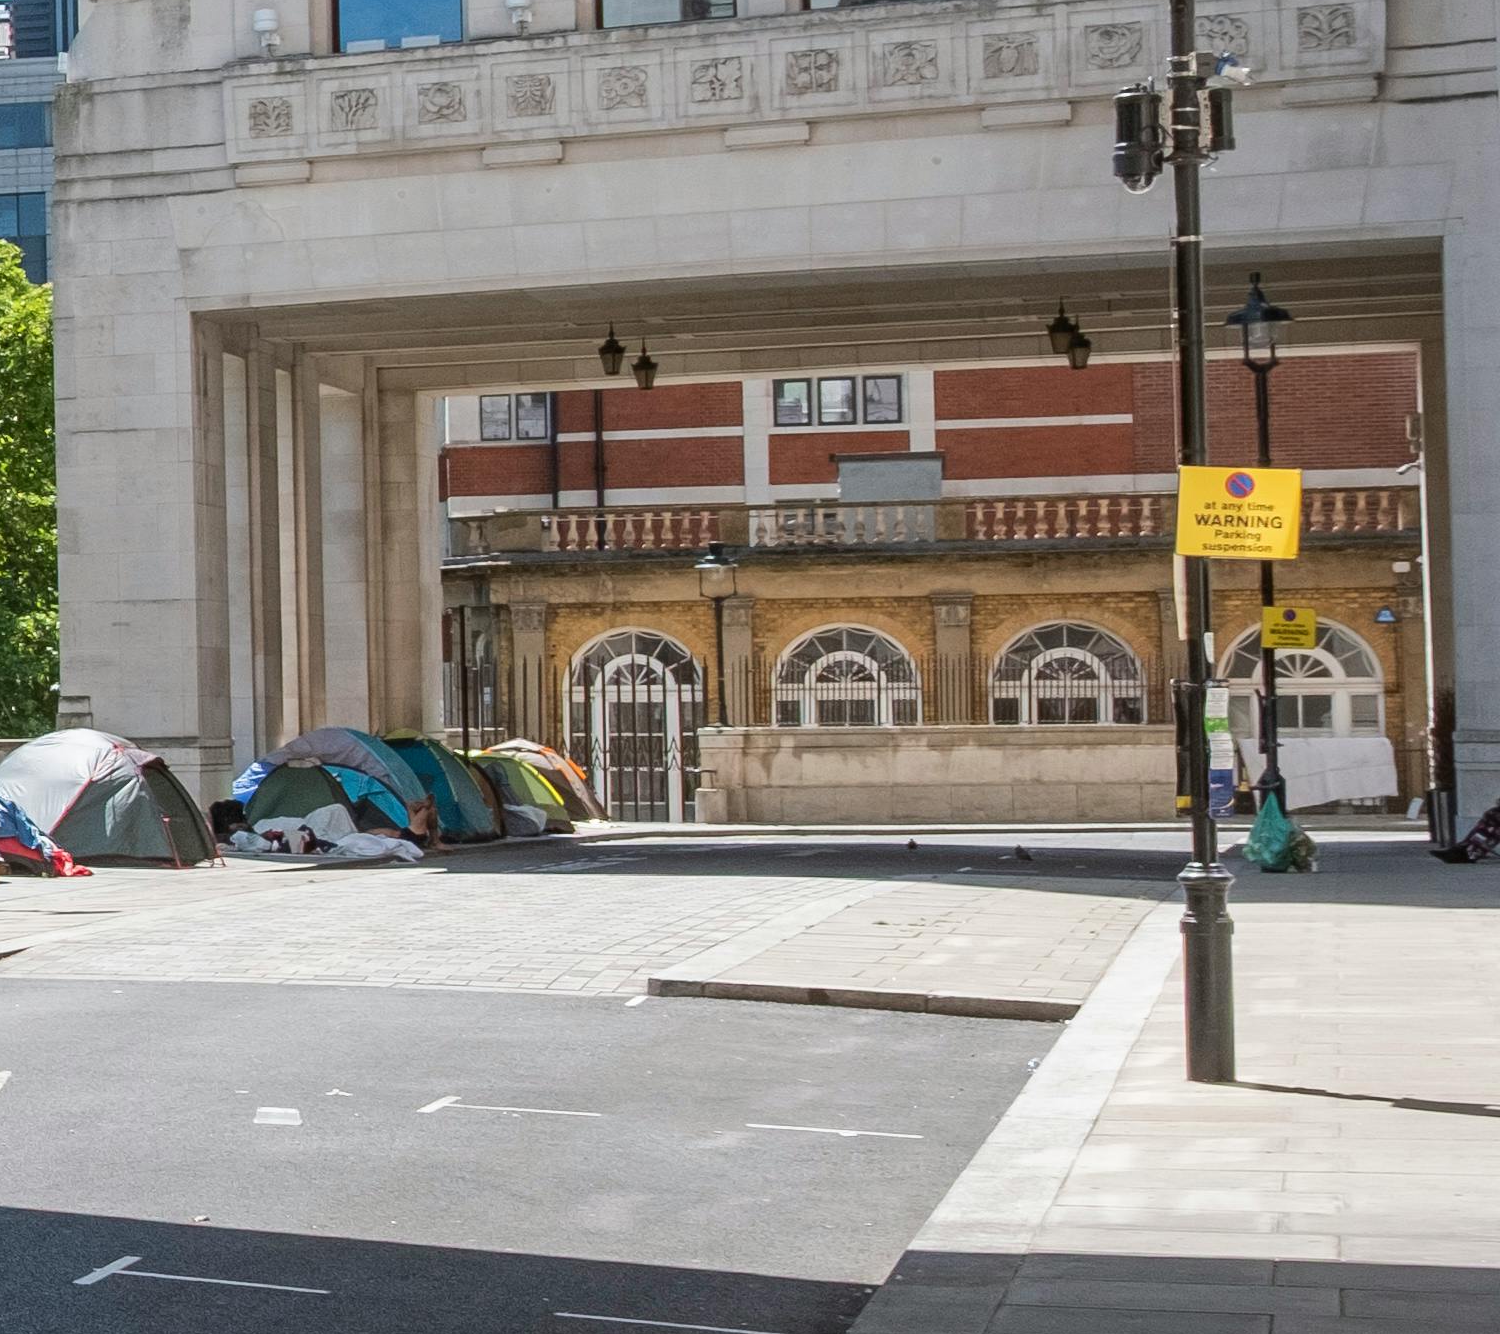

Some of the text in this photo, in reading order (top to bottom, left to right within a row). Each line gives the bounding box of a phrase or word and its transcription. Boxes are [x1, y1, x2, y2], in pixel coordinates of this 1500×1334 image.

[1221, 502, 1243, 512] any
[1248, 502, 1275, 512] time
[1194, 514, 1283, 529] WARNING
[1214, 530, 1262, 542] Parking
[1202, 542, 1273, 553] suspension
